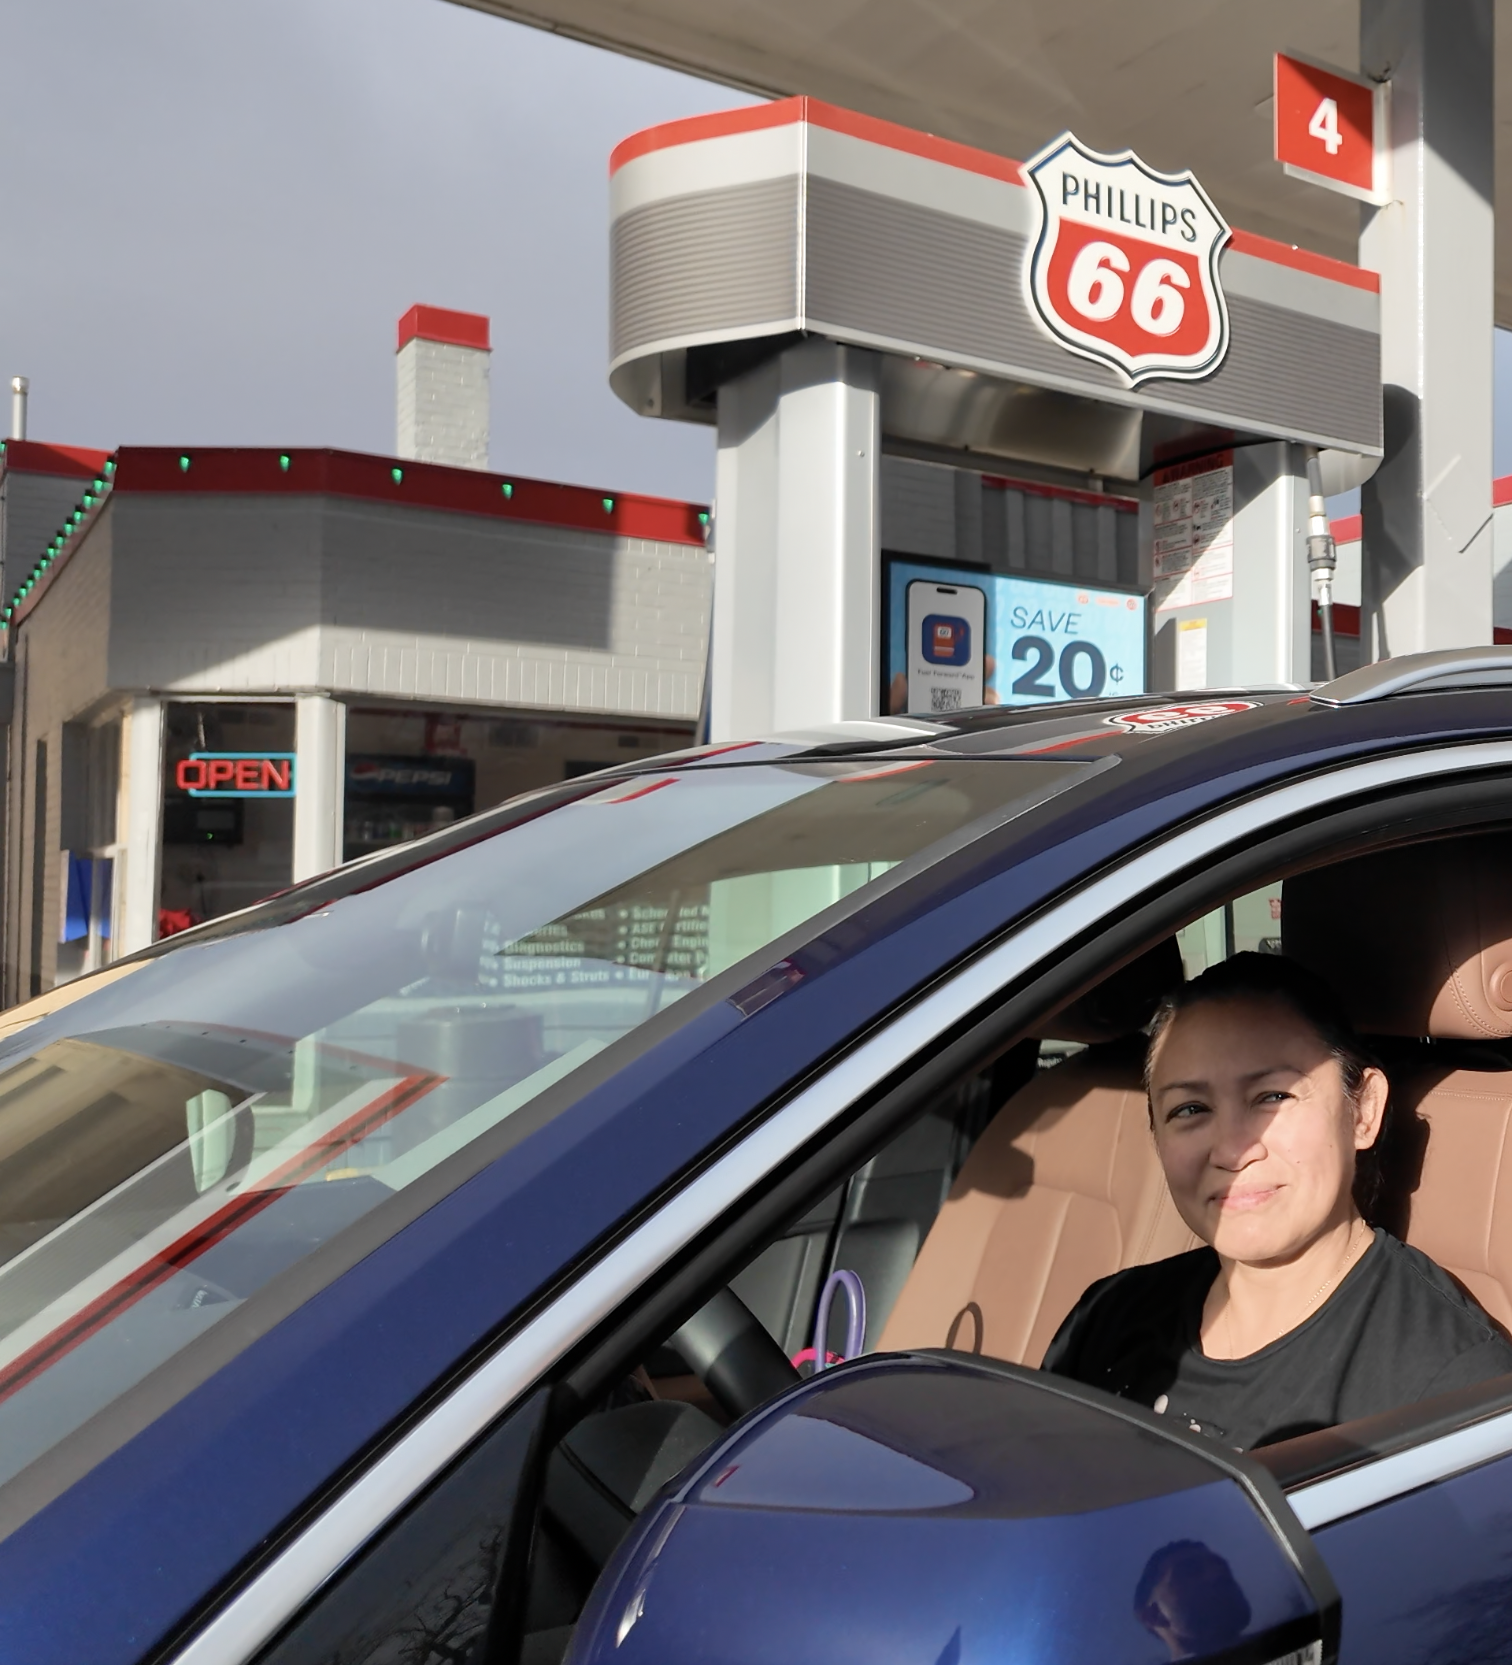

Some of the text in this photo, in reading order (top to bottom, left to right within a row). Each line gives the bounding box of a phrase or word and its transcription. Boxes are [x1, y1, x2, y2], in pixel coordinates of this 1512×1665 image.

[1308, 97, 1343, 155] 4
[1062, 170, 1198, 243] PHILLIPS
[1066, 240, 1191, 338] 66
[1010, 606, 1081, 635] SAVE
[176, 758, 290, 791] OPEN
[379, 768, 452, 786] PEPSI
[504, 938, 585, 955] Diagnostics
[503, 956, 581, 972] Suspension
[503, 970, 610, 988] Shocks & Struts
